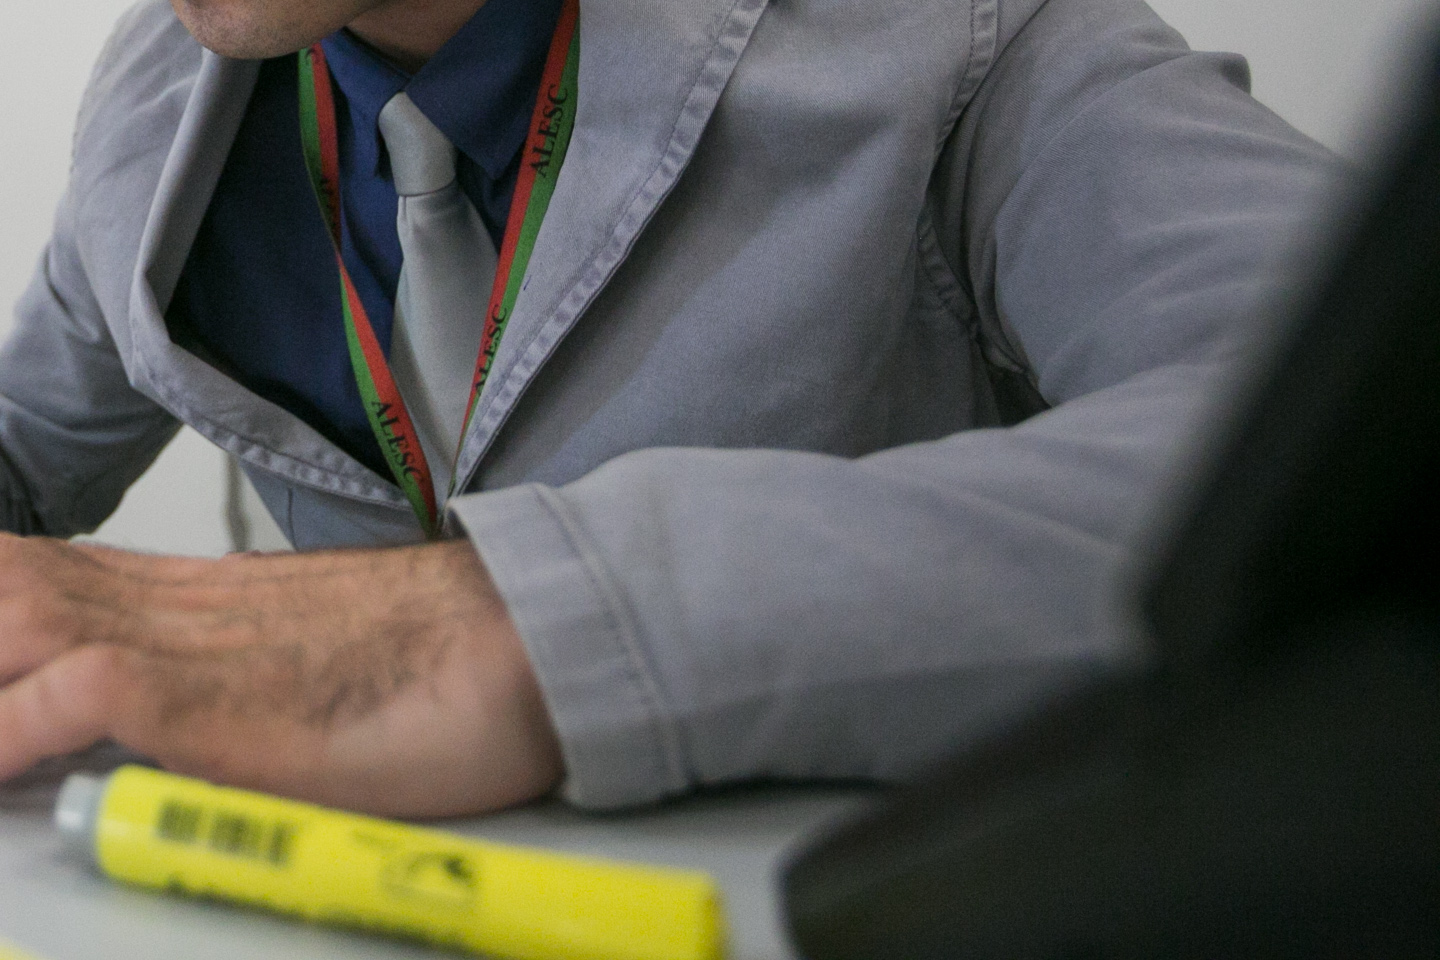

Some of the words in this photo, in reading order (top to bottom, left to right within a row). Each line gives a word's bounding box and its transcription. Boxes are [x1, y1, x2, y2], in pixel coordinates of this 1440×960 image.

[529, 83, 569, 178] ALESC
[476, 303, 508, 396] ALESC
[371, 399, 424, 484] ALESC
